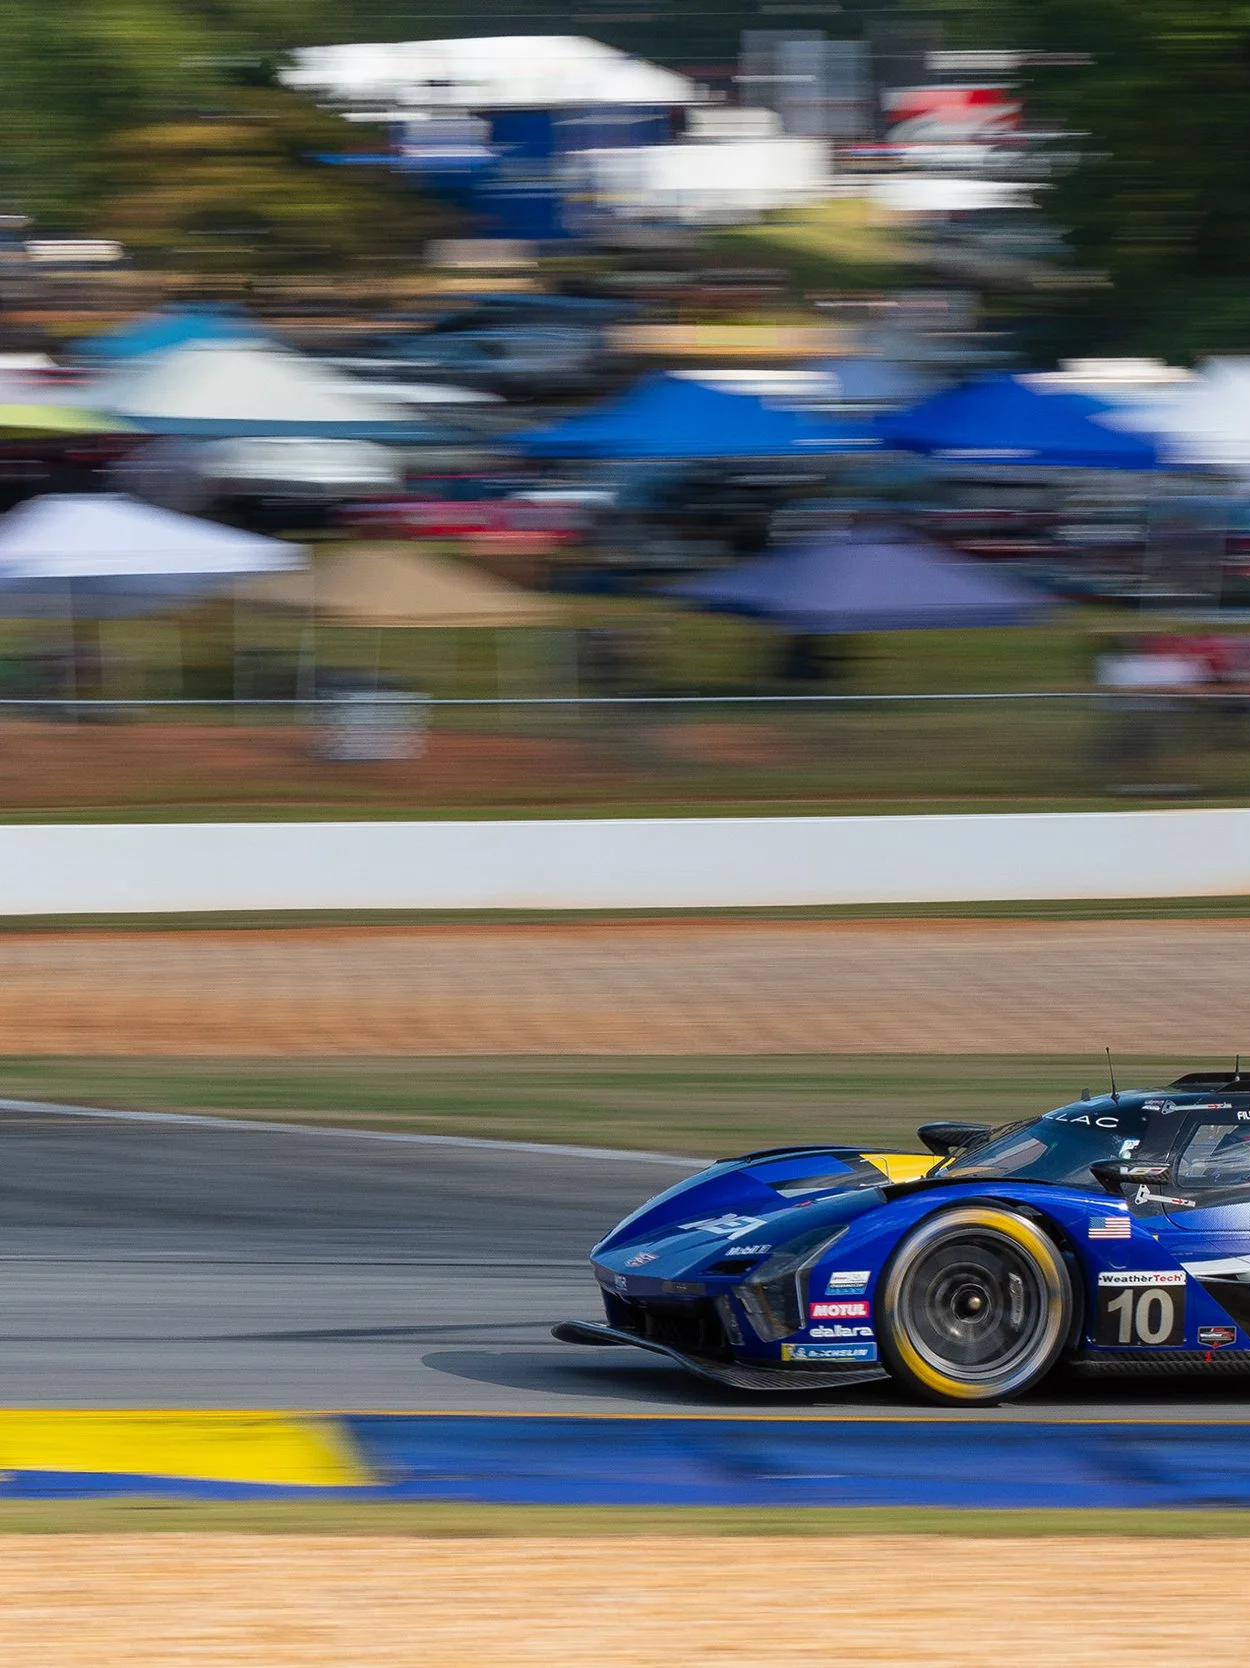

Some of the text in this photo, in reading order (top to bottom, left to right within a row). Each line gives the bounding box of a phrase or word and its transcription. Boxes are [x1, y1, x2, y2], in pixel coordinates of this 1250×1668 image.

[812, 1303, 867, 1317] MOTUL
[1107, 1288, 1175, 1345] 10
[809, 1324, 875, 1338] dallara
